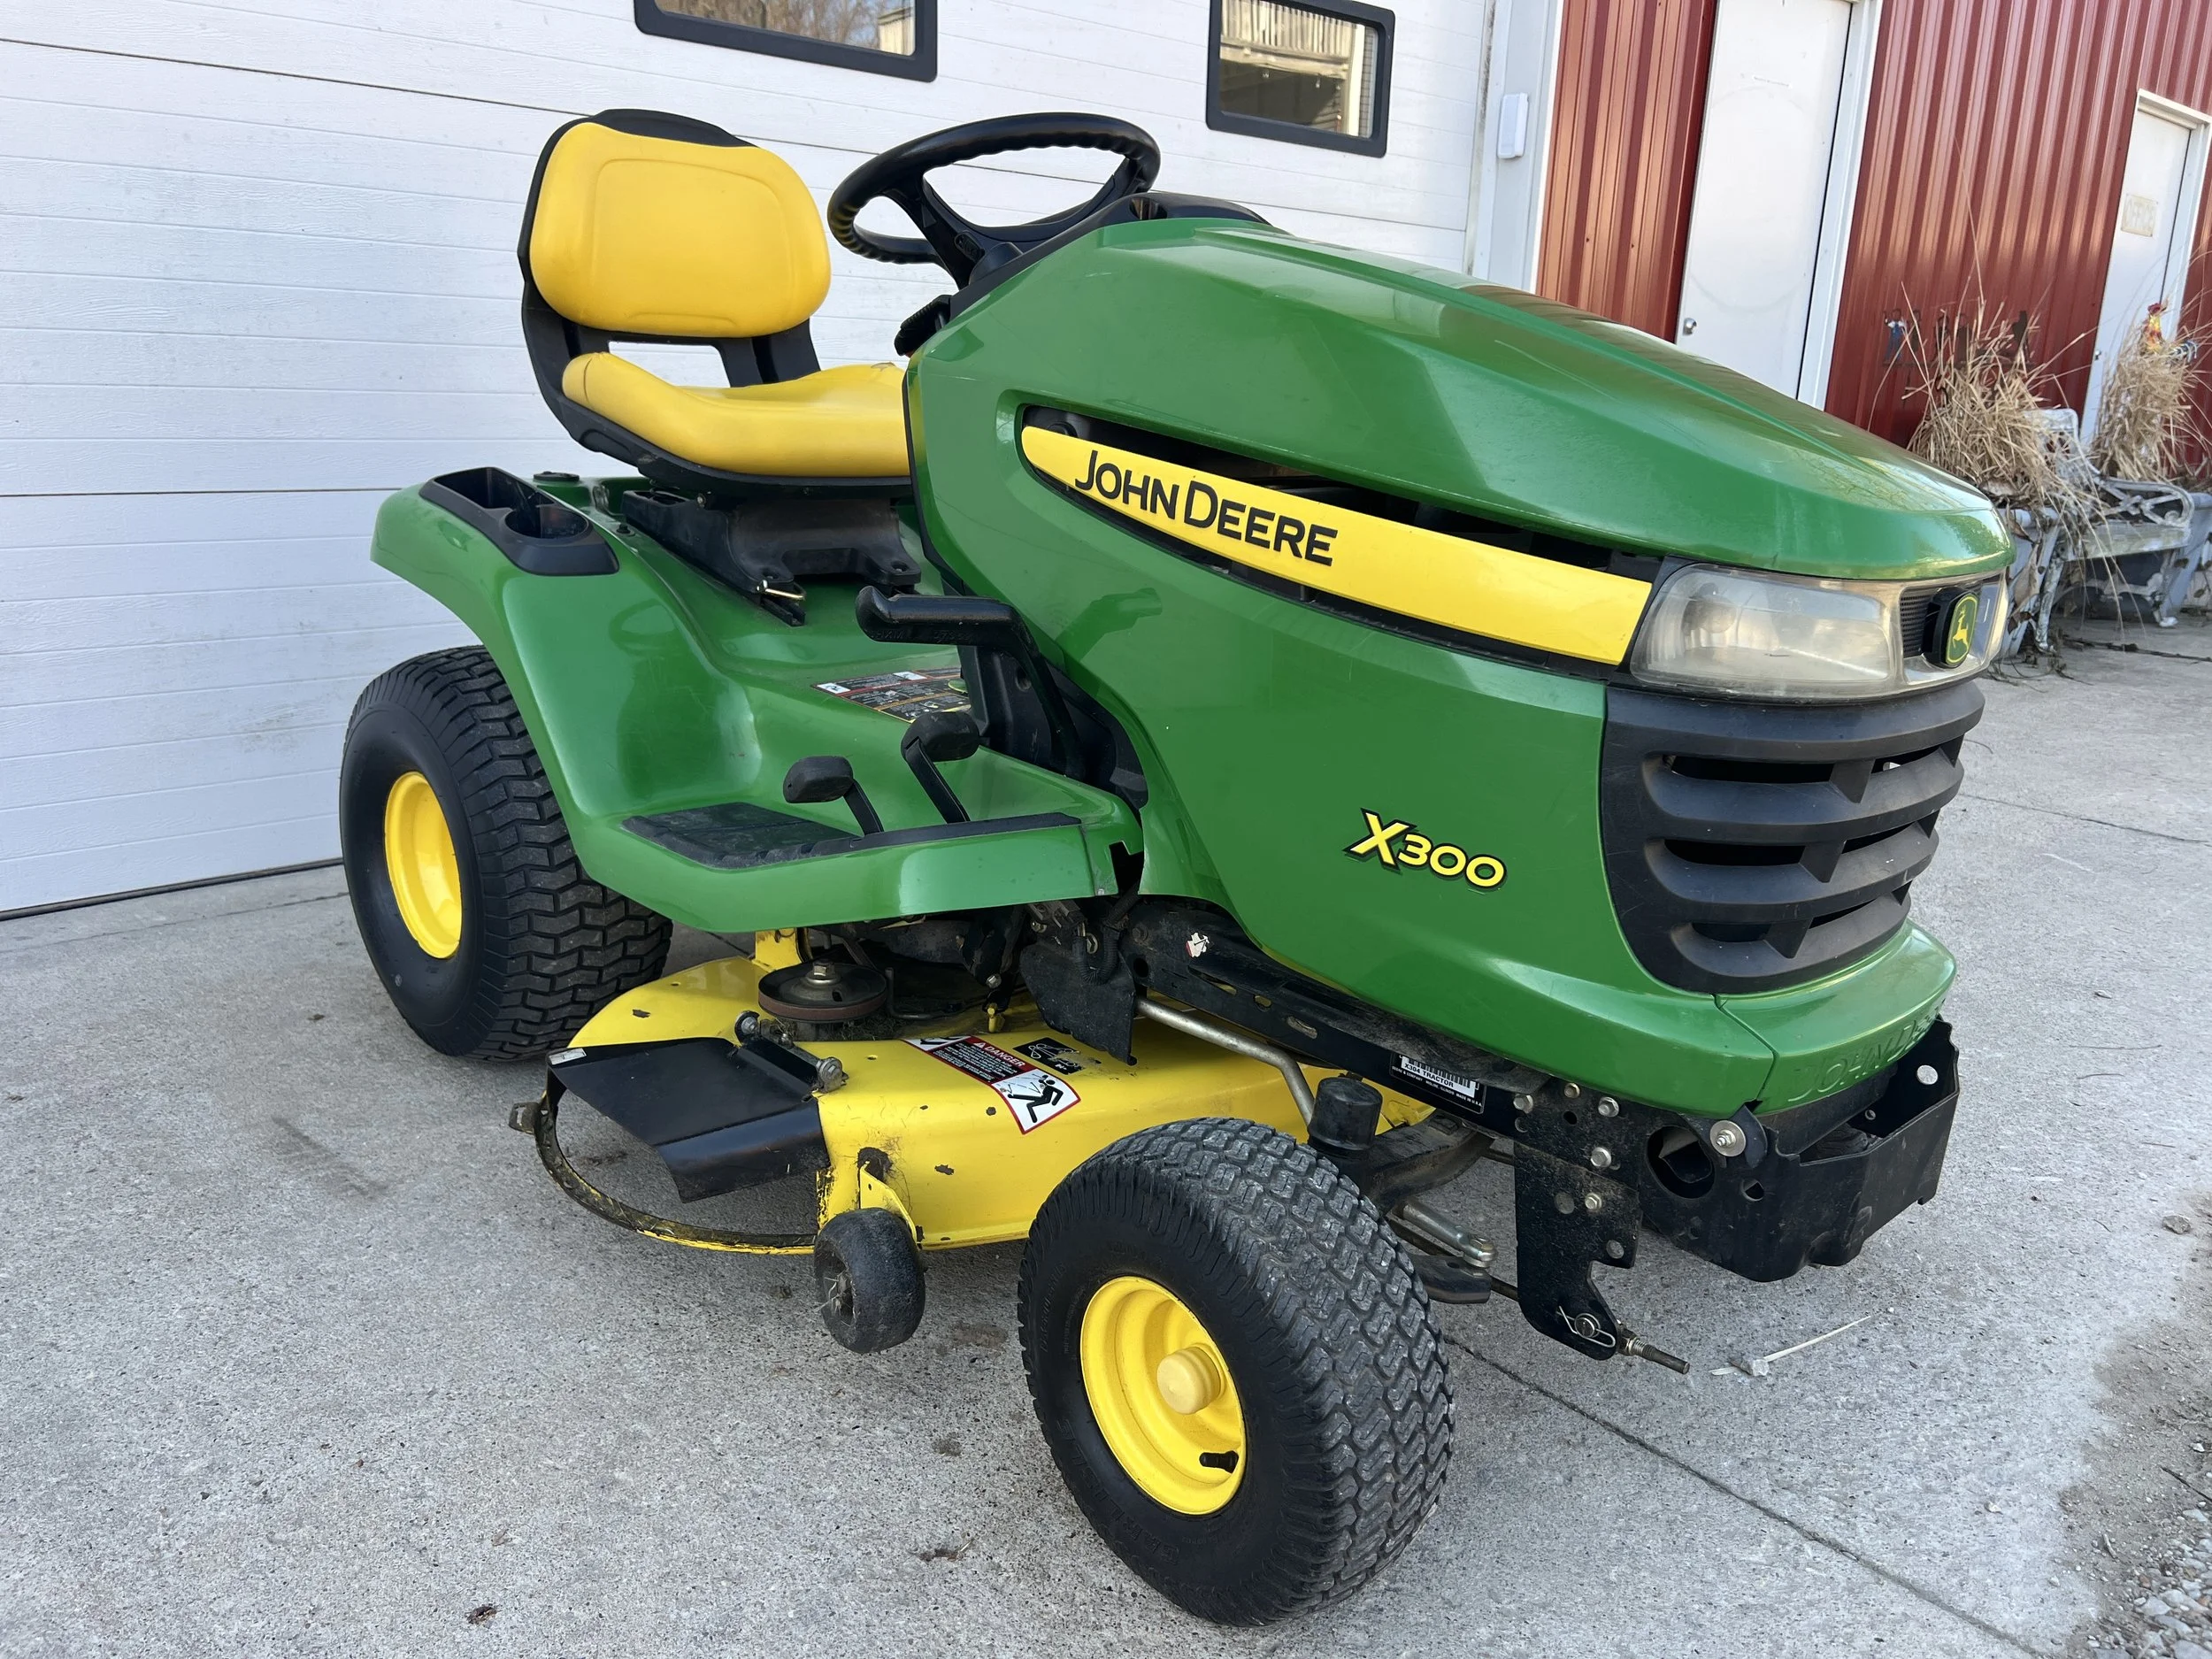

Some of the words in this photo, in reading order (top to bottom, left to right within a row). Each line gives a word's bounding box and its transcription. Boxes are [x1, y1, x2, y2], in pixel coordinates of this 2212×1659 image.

[1074, 449, 1180, 520] JOHN
[1184, 480, 1338, 567] DEERE
[1346, 810, 1507, 890] X300
[985, 1045, 1026, 1067] DANGER
[1404, 1063, 1421, 1073] X304
[1422, 1070, 1455, 1087] TRACTOR
